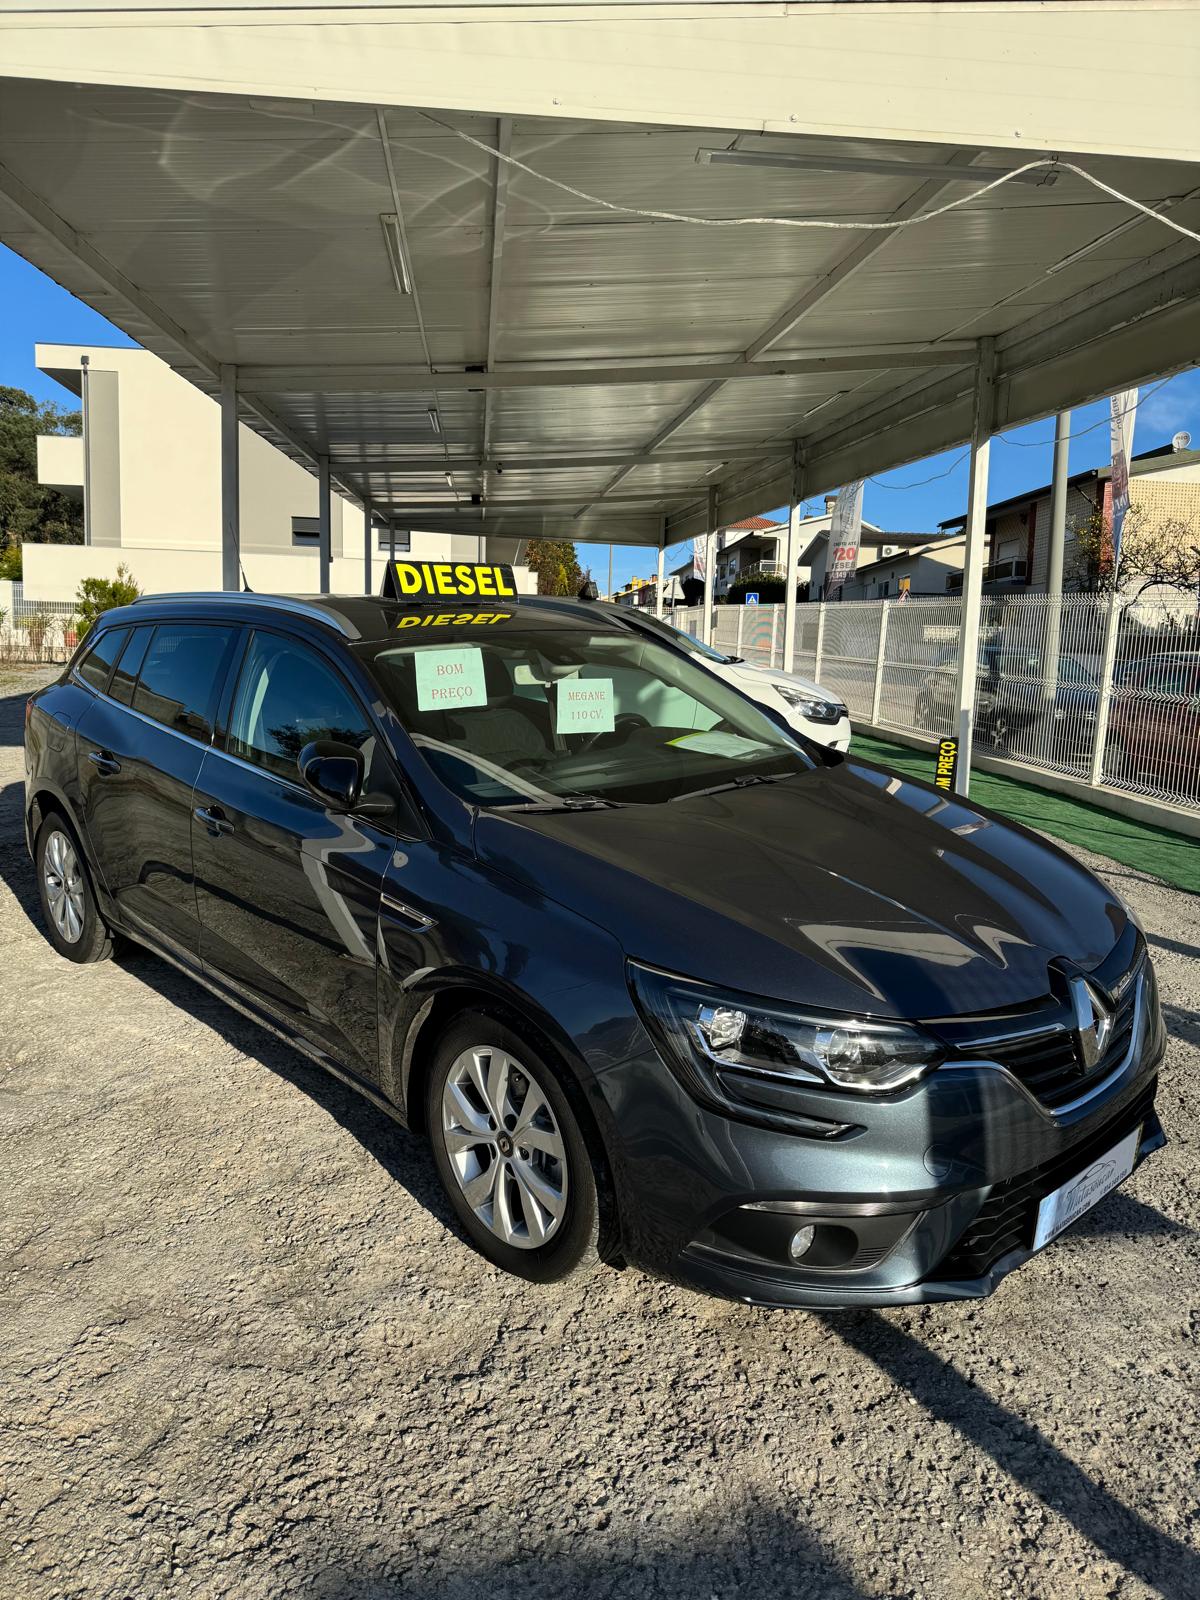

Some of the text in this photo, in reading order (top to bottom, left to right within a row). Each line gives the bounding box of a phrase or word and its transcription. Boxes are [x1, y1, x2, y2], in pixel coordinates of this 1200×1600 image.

[395, 563, 514, 596] DIESEL
[436, 664, 464, 676] BOM
[431, 686, 473, 700] PREÇO
[568, 691, 606, 701] MEGANE
[937, 741, 958, 775] PREÇO
